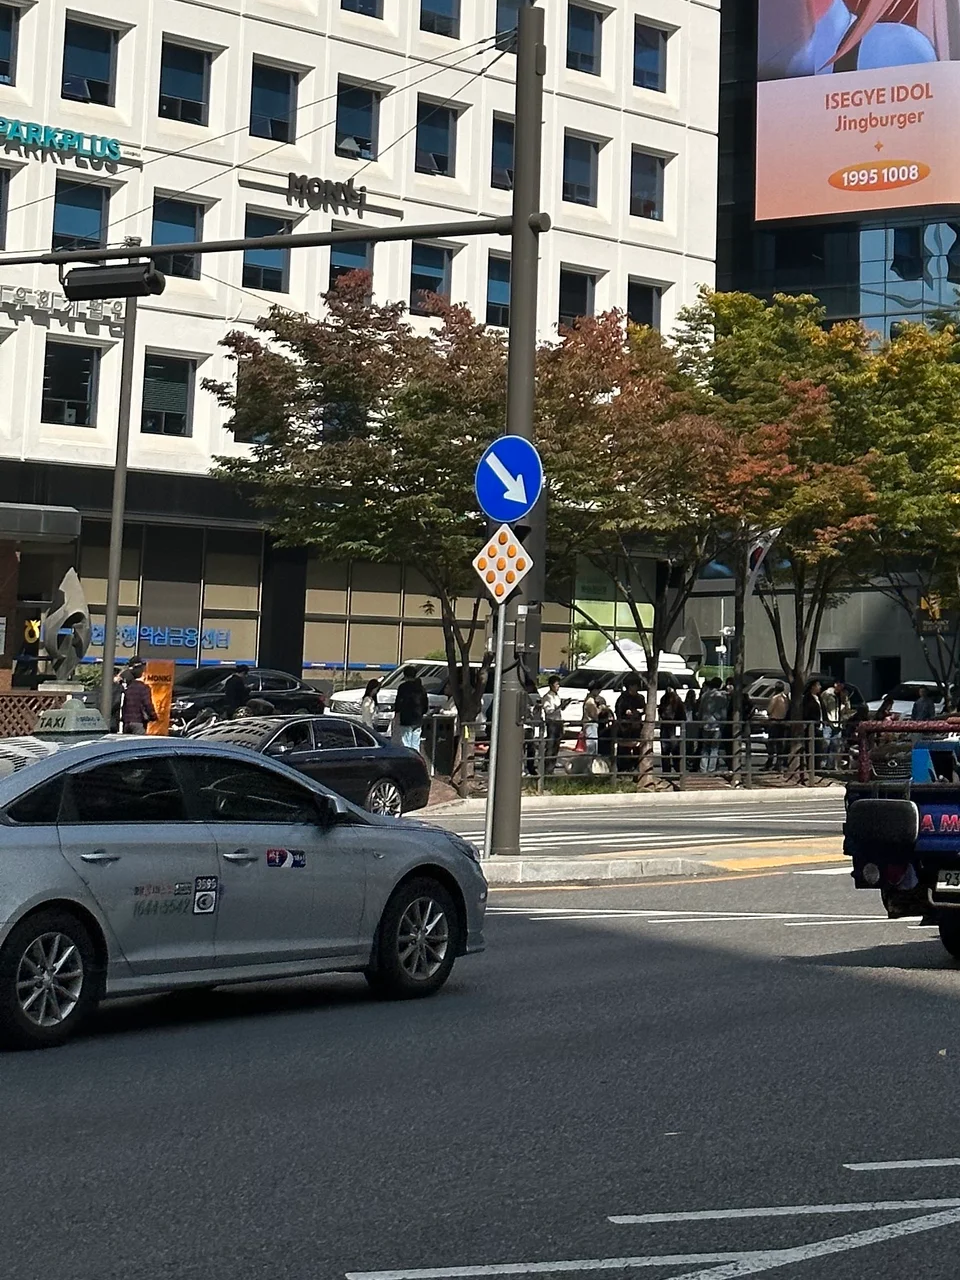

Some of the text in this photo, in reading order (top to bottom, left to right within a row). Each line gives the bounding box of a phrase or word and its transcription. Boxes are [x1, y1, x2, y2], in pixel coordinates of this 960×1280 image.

[824, 81, 934, 112] ISEGYE IDOL
[834, 106, 926, 134] Jingburger
[841, 163, 919, 187] 1995 1008
[39, 717, 67, 729] TAXI
